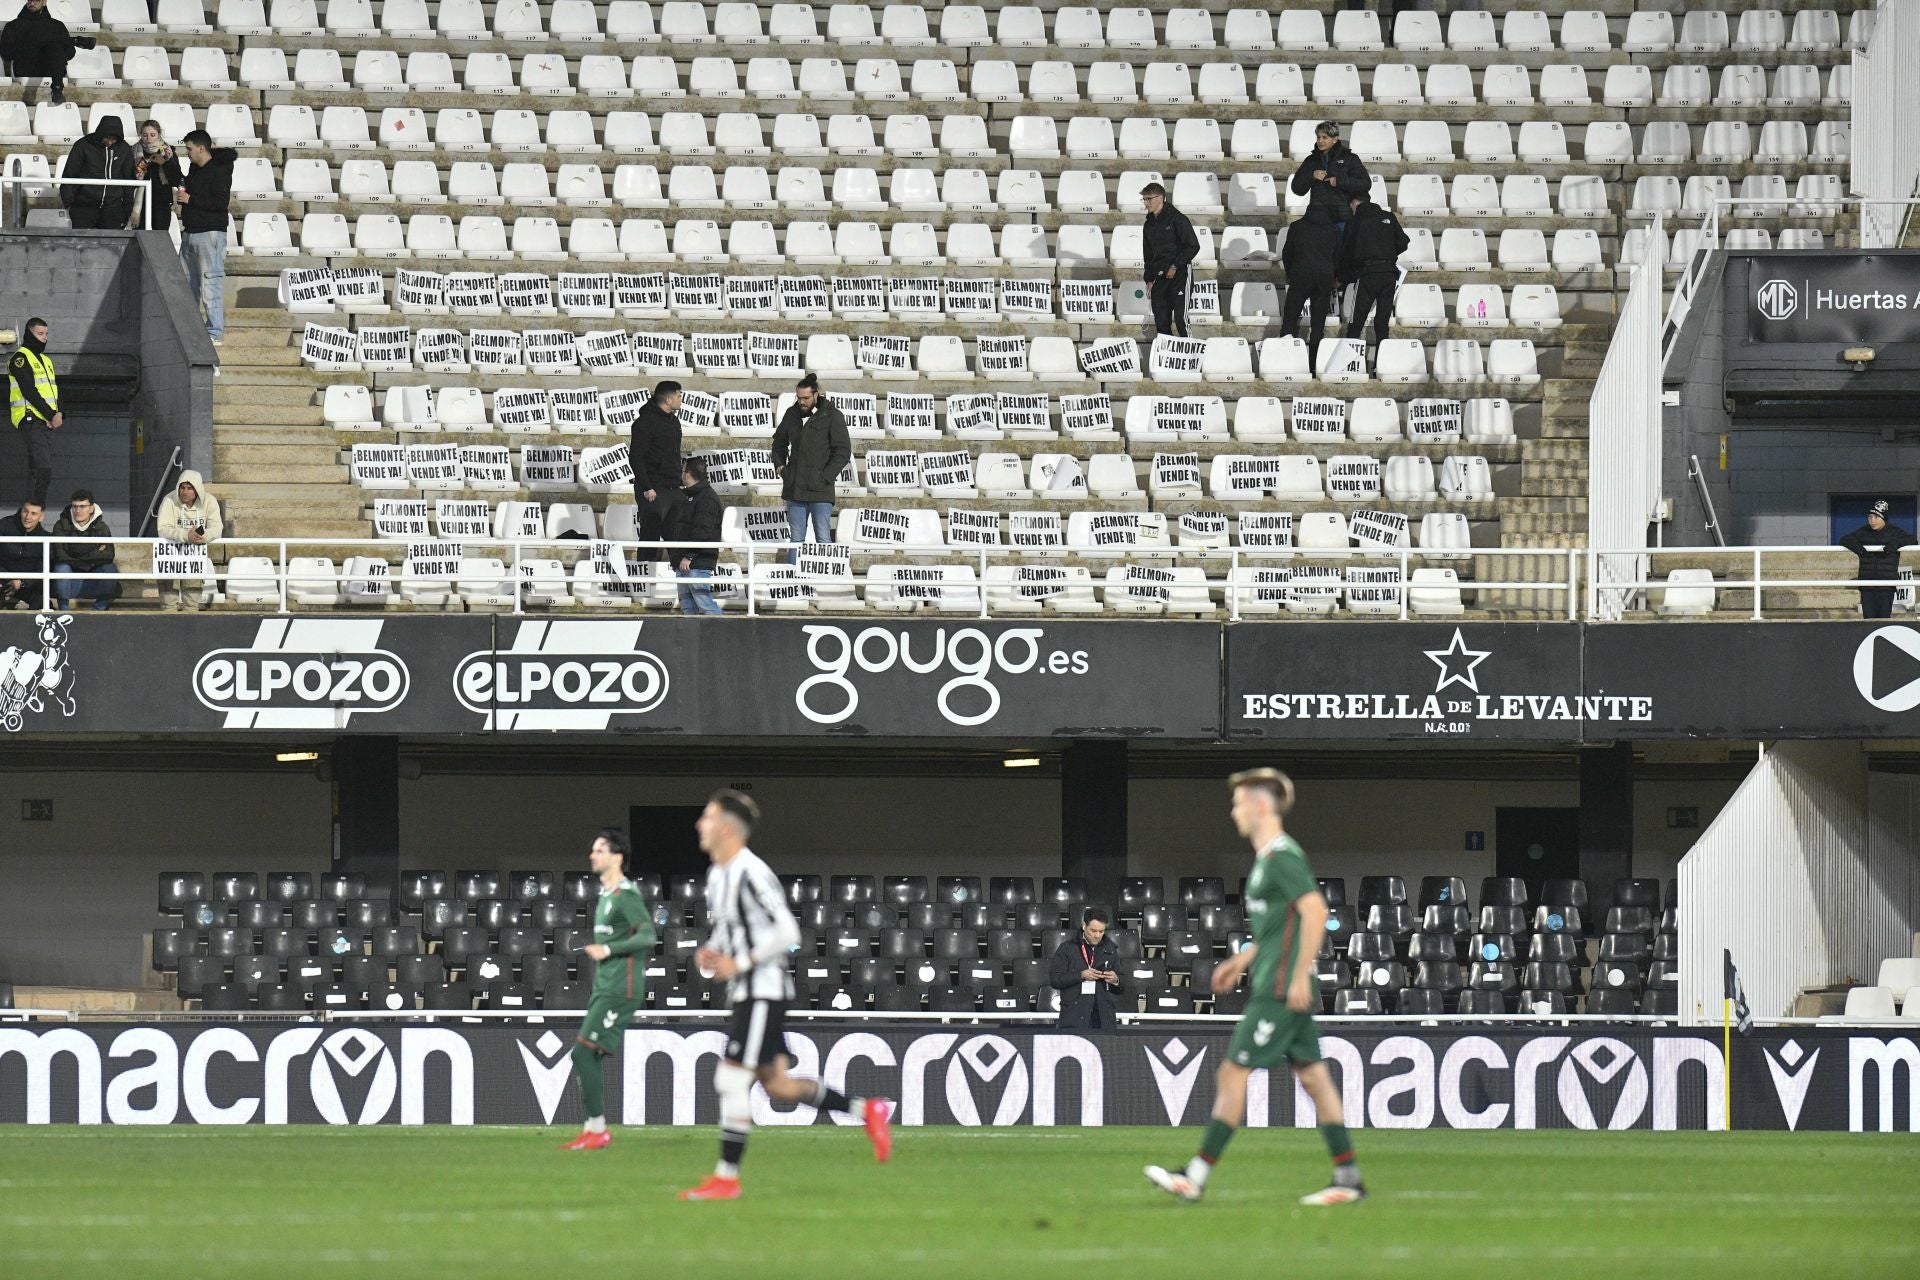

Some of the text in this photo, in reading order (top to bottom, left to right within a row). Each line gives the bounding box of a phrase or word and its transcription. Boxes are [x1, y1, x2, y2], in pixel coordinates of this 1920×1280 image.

[446, 277, 495, 293] ¡BELMONTE
[500, 278, 550, 293] ¡BELMONTE
[560, 277, 609, 290] ¡BELMONTE
[615, 276, 663, 289] ¡BELMONTE
[671, 276, 720, 289] ¡BELMONTE
[726, 281, 774, 294] ¡BELMONTE
[833, 279, 882, 292] ¡BELMONTE
[946, 281, 993, 294] ¡BELMONTE
[1002, 281, 1050, 294] ¡BELMONTE
[1062, 283, 1111, 297] ¡BELMONTE
[450, 294, 493, 306] VENDE YA!
[504, 294, 548, 307] VENDE YA!
[563, 294, 606, 305] VENDE YA!
[619, 292, 662, 303] VENDE YA!
[675, 293, 717, 304] VENDE YA!
[729, 296, 772, 308] VENDE YA!
[785, 295, 826, 307] VENDE YA!
[838, 296, 880, 306] VENDE YA!
[949, 297, 991, 308] VENDE YA!
[1005, 295, 1047, 309] VENDE YA!
[1762, 284, 1794, 316] MG
[1816, 289, 1907, 310] Huertas
[1066, 301, 1108, 312] VENDE YA!
[305, 328, 356, 350] ¡BELMONTE
[361, 330, 408, 346] ¡BELMONTE
[525, 333, 574, 348] ¡BELMONTE
[634, 336, 682, 351] ¡BELMONTE
[307, 344, 348, 362] VENDE YA!
[364, 347, 406, 360] VENDE YA!
[530, 349, 572, 363] VENDE YA!
[638, 352, 678, 367] VENDE YA!
[697, 355, 740, 366] VENDE YA!
[752, 354, 794, 367] VENDE YA!
[551, 391, 598, 406] ¡BELMONTE
[888, 398, 933, 410] ¡BELMONTE
[1000, 397, 1047, 410] ¡BELMONTE
[557, 408, 596, 421] VENDE YA!
[1154, 402, 1205, 416] ¡BELMONTE
[1294, 402, 1344, 416] ¡BELMONTE
[1410, 404, 1460, 420] ¡BELMONTE
[501, 409, 545, 424] VENDE YA!
[918, 415, 930, 426] YA!
[1002, 413, 1045, 425] VENDE YA!
[1158, 418, 1202, 430] VENDE YA!
[1296, 419, 1340, 432] VENDE YA!
[1414, 420, 1457, 433] VENDE YA!
[354, 450, 404, 463] ¡BELMONTE
[407, 448, 457, 465] ¡BELMONTE
[459, 450, 508, 464] ¡BELMONTE
[867, 454, 917, 469] ¡BELMONTE
[921, 453, 970, 472] ¡BELMONTE
[358, 466, 401, 478] VENDE YA!
[412, 465, 455, 479] VENDE YA!
[492, 469, 505, 480] YA!
[1229, 461, 1280, 475] ¡BELMONTE
[871, 472, 915, 483] VENDE YA!
[925, 470, 969, 485] VENDE YA!
[1232, 478, 1276, 489] VENDE YA!
[860, 510, 909, 528] ¡BELMONTE
[950, 512, 998, 527] ¡BELMONTE
[1091, 515, 1138, 532] ¡BELMONTE
[1353, 511, 1406, 530] ¡BELMONTE
[862, 525, 905, 542] VENDE YA!
[952, 529, 995, 544] VENDE YA!
[1095, 531, 1124, 545] VENDE
[1353, 523, 1397, 546] VENDE YA!
[410, 544, 461, 560] ¡BELMONTE
[798, 543, 849, 558] ¡BELMONTE
[158, 562, 202, 573] VENDE YA!
[414, 562, 458, 575] VENDE YA!
[801, 561, 844, 575] VENDE YA!
[898, 586, 941, 598] VENDE YA!
[1352, 589, 1395, 600] VENDE YA!
[1242, 694, 1653, 720] ESTRELLA DE LEVANTE
[0, 1028, 473, 1125] macron
[623, 1029, 1103, 1127] macron
